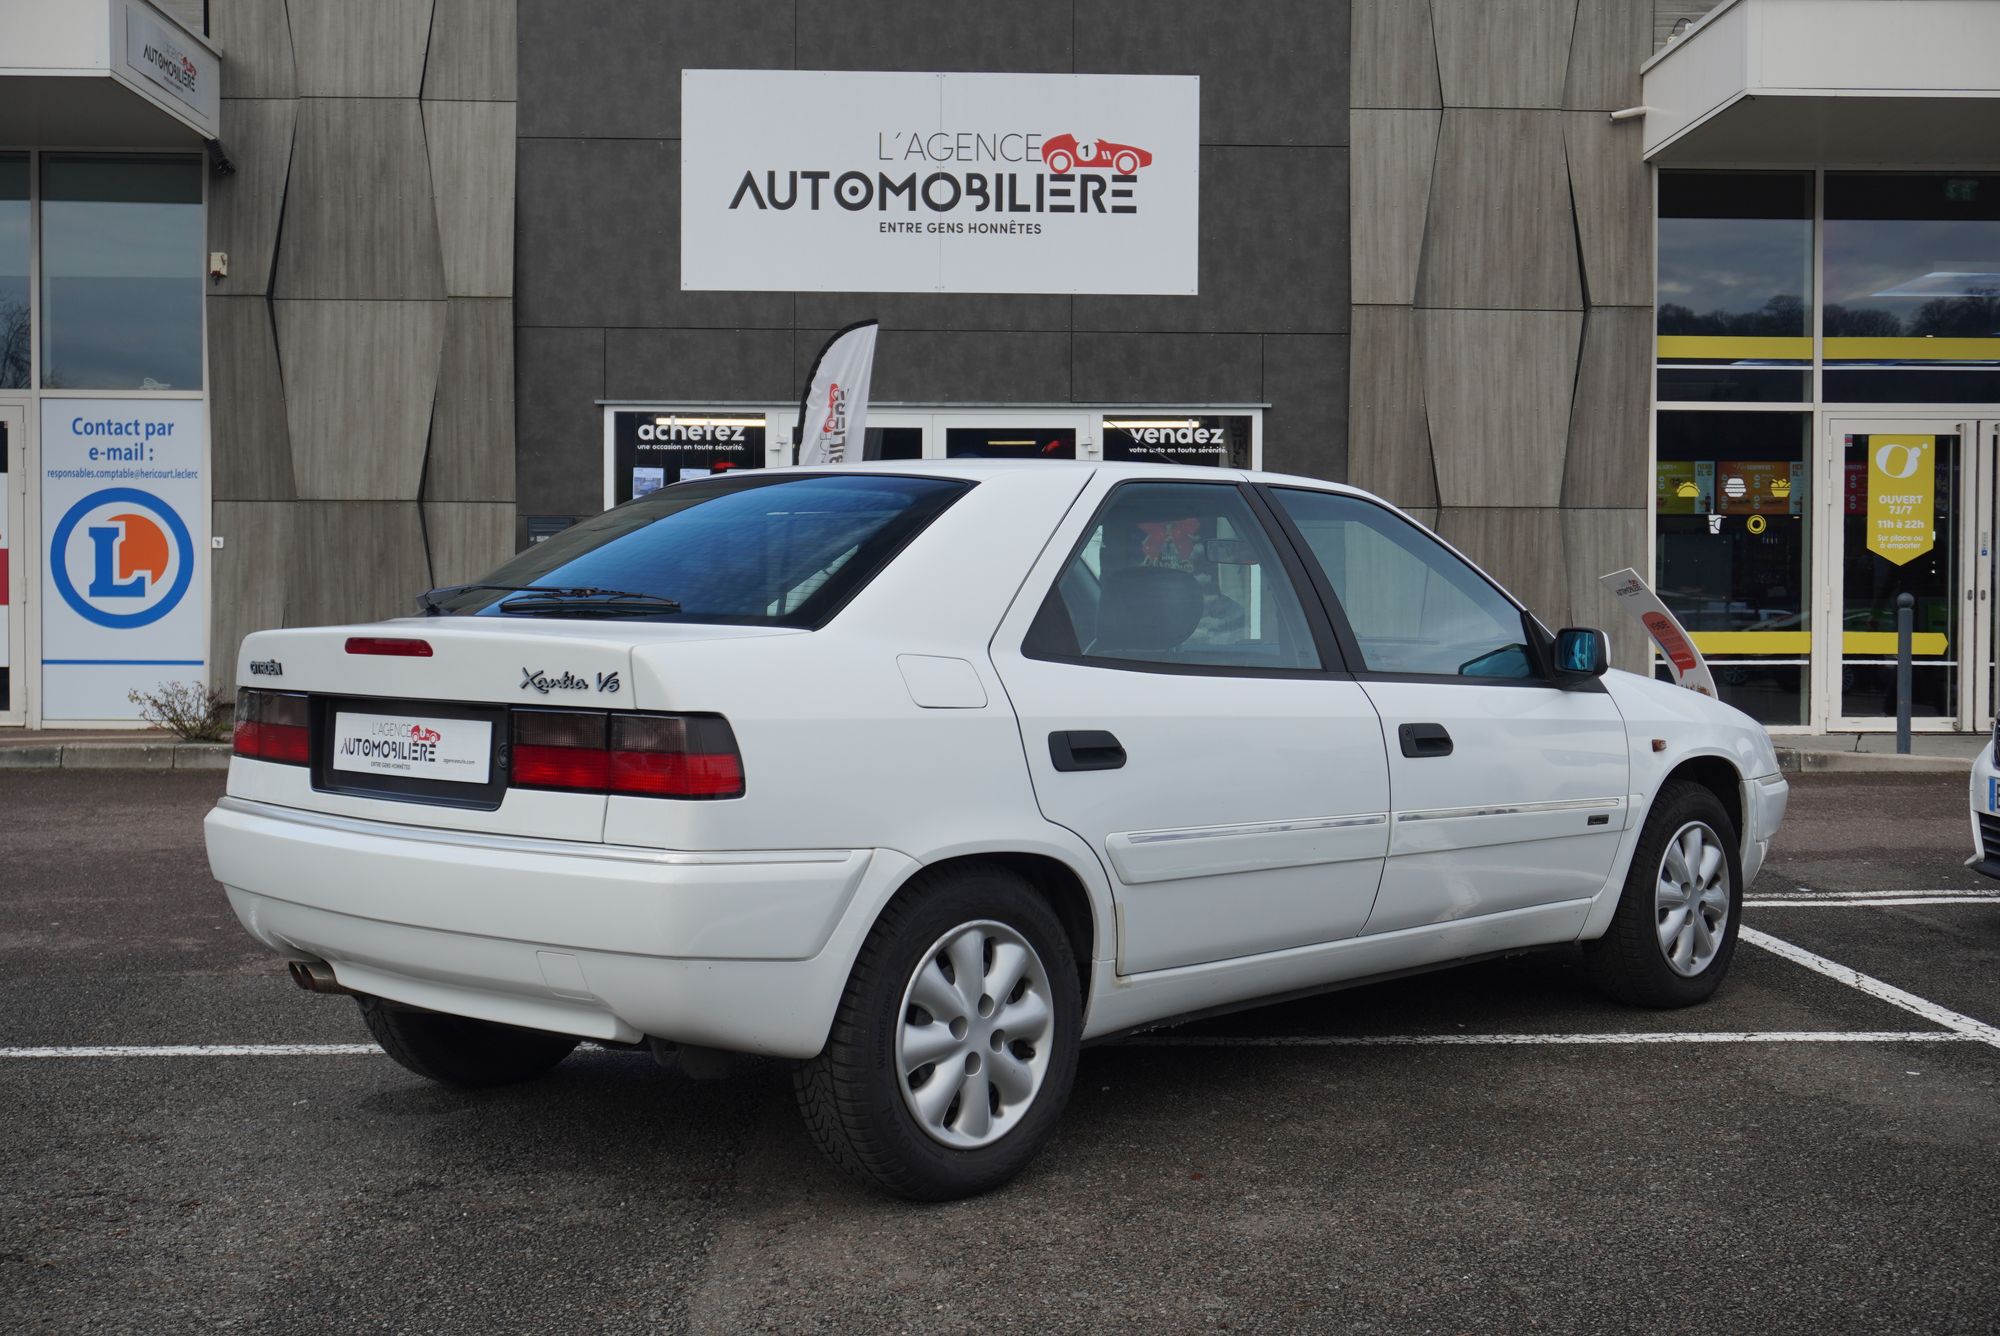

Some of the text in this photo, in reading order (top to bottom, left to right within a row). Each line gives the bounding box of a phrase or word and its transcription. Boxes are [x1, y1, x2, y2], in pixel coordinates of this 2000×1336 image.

[878, 131, 1042, 162] L'AGENCE
[1082, 144, 1090, 157] 1
[728, 169, 1138, 214] AUTOMOBILIERE
[879, 219, 1042, 234] ENTRE GENS HONNÊTES
[72, 417, 175, 441] Contact par
[637, 415, 745, 441] achetez
[1129, 418, 1224, 444] vendez
[88, 442, 144, 461] e-mail
[652, 442, 681, 450] occasion
[715, 443, 745, 451] sécurité.
[1199, 446, 1228, 454] sérénité.
[47, 467, 199, 480] responsables.comptable@hericourt.leclerc
[1878, 495, 1923, 504] OUVERT
[1877, 519, 1894, 529] 11h
[1904, 519, 1925, 529] 22h
[520, 666, 620, 695] Xantia V6
[371, 721, 412, 738] L'AGENCE
